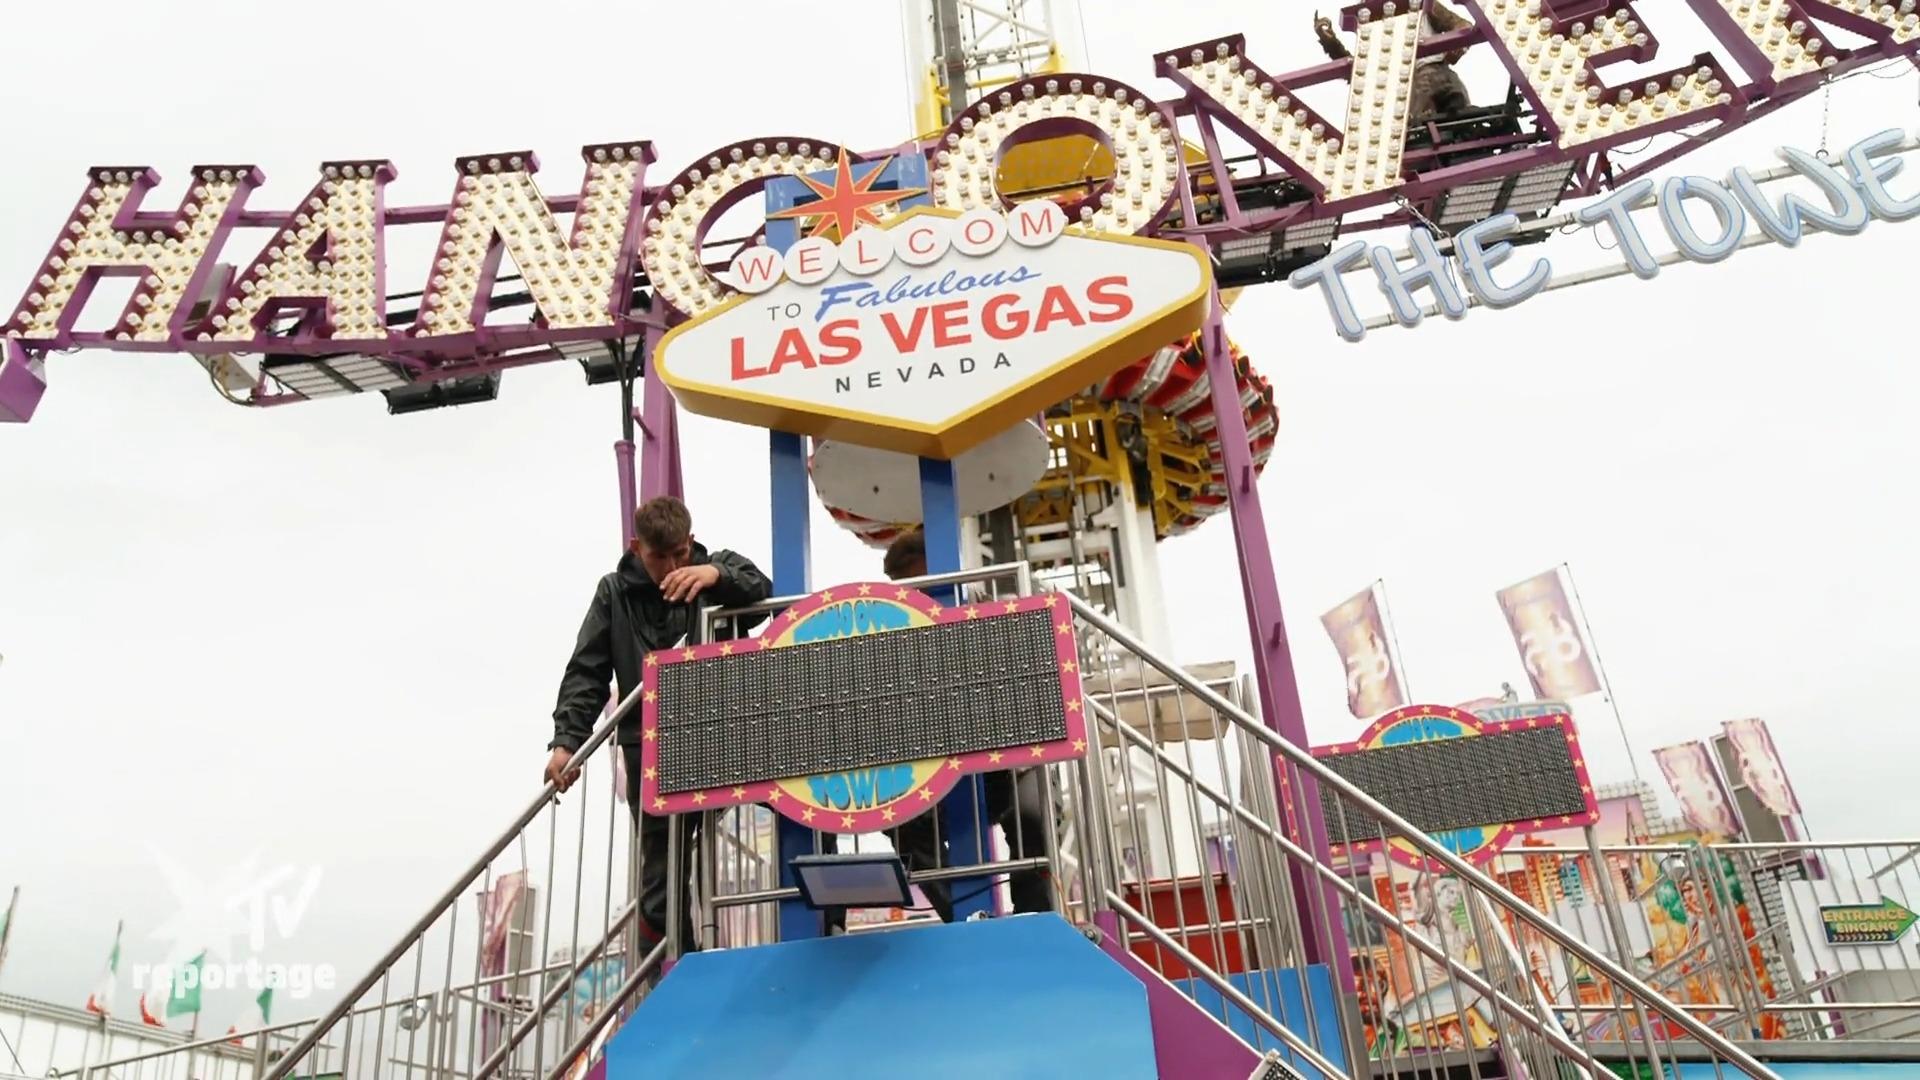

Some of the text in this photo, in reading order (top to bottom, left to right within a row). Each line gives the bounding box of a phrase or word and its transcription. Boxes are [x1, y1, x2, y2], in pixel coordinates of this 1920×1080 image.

[738, 208, 1053, 285] WELCOM
[767, 264, 1042, 322] TO Fabulous
[1288, 212, 1552, 342] THE
[730, 276, 1134, 381] LAS VEGAS
[834, 352, 1011, 393] NEVADA
[1822, 909, 1907, 921] ENTRANCE
[1836, 921, 1898, 933] EINGANG
